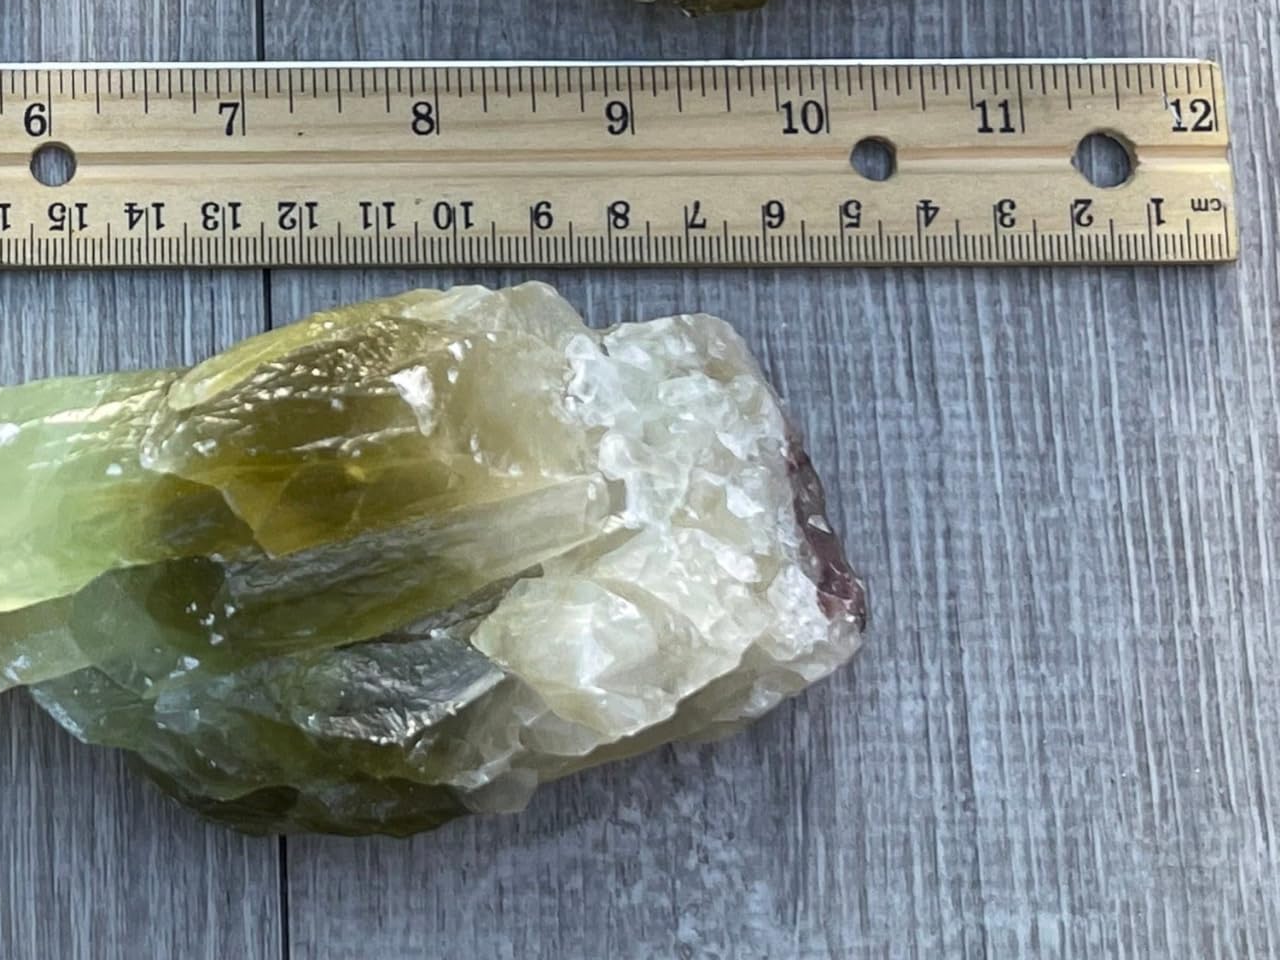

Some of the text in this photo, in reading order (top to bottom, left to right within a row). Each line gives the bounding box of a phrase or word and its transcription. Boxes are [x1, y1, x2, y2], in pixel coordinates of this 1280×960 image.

[24, 103, 48, 136] 6
[218, 103, 240, 136] 7
[412, 102, 435, 135] 8
[606, 101, 630, 135] 9
[781, 100, 824, 134] 10
[976, 99, 1017, 133] 11
[1170, 98, 1213, 132] 12
[47, 203, 89, 231] 15
[124, 202, 166, 230] 14
[201, 202, 242, 230] 13
[277, 201, 319, 229] 12
[359, 201, 396, 229] 11
[433, 201, 475, 229] 10
[533, 201, 553, 229] 9
[610, 201, 630, 229] 8
[687, 201, 706, 228] 7
[765, 200, 785, 228] 6
[843, 200, 862, 227] 5
[919, 200, 940, 227] 4
[996, 200, 1016, 227] 3
[1073, 199, 1093, 226] 2
[1150, 197, 1165, 225] 1
[1190, 198, 1222, 212] cm
